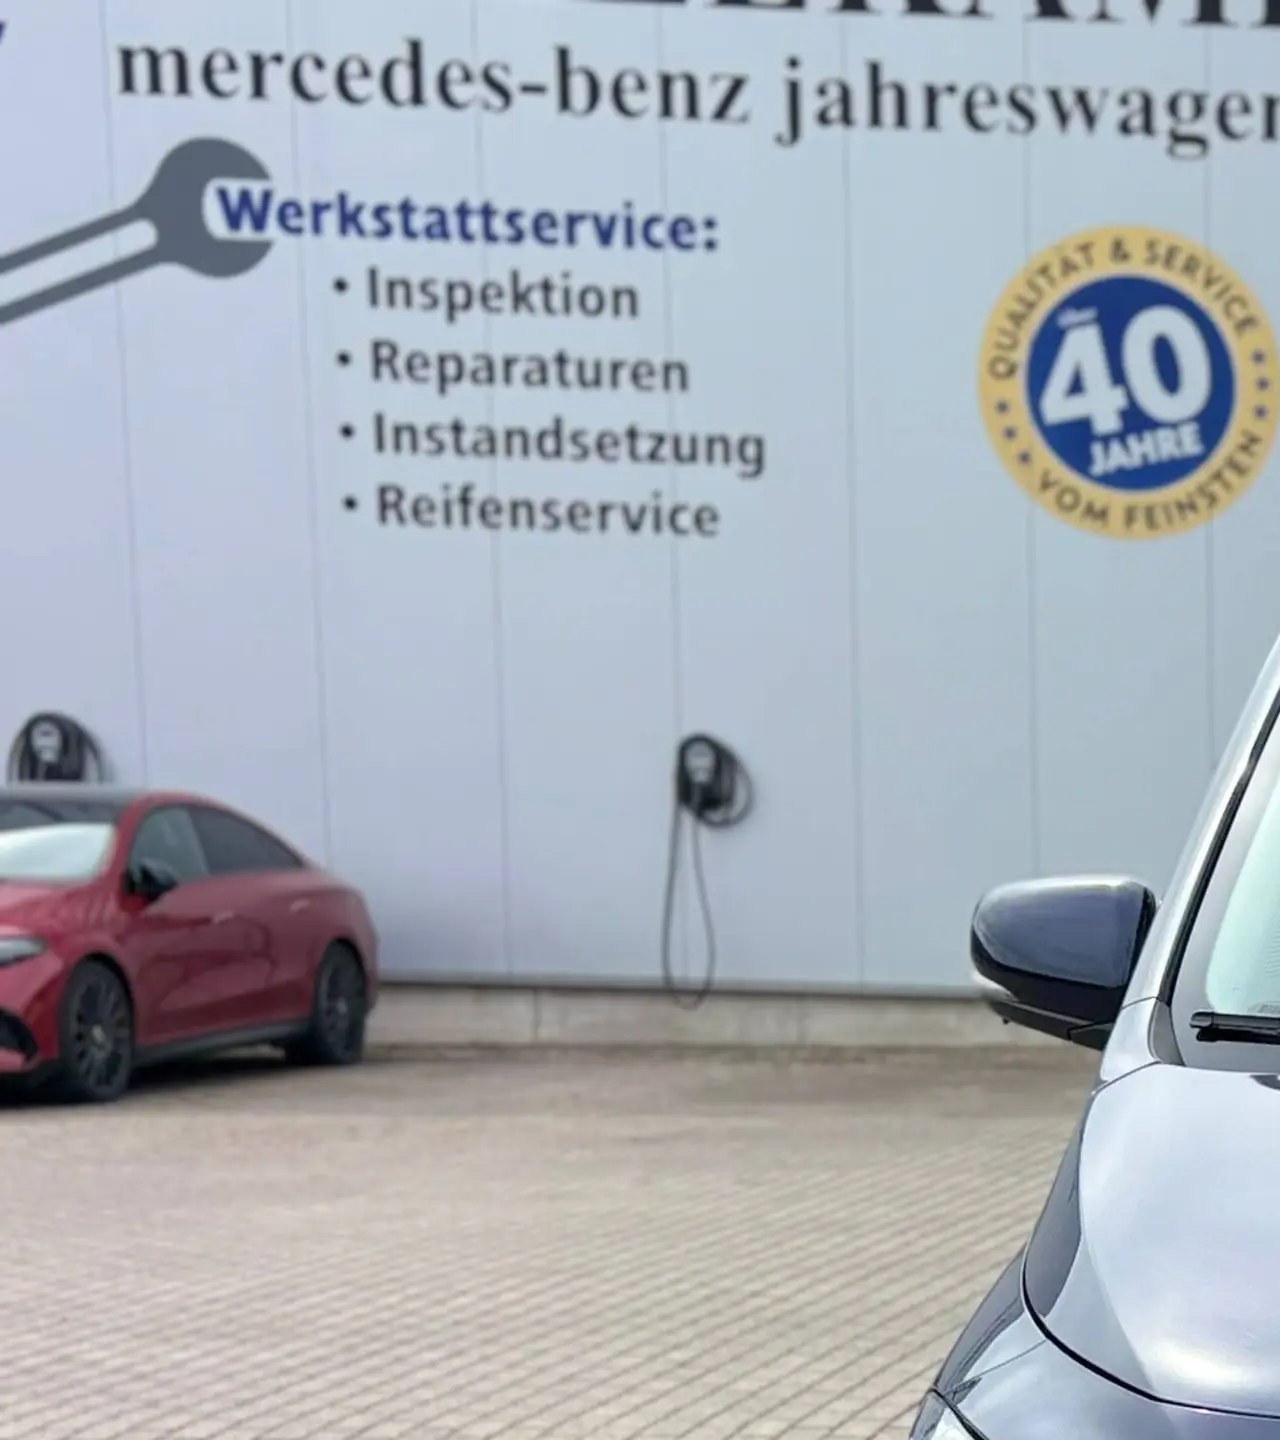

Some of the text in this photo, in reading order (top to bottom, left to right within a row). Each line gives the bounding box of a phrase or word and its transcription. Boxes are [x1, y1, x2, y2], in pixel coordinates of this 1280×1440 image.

[116, 38, 750, 124] mercedes-benz
[216, 185, 719, 251] Werkstattservice:
[366, 266, 640, 324] Inspektion
[1109, 236, 1131, 264] &
[1145, 238, 1260, 339] SERVICE
[371, 339, 690, 396] Reparaturen
[1040, 304, 1211, 437] 40
[373, 412, 766, 479] Instandsetzung
[1089, 421, 1204, 477] JAHRE
[378, 485, 721, 539] Reifenservice
[1037, 429, 1263, 531] VOM FEINSTEN
